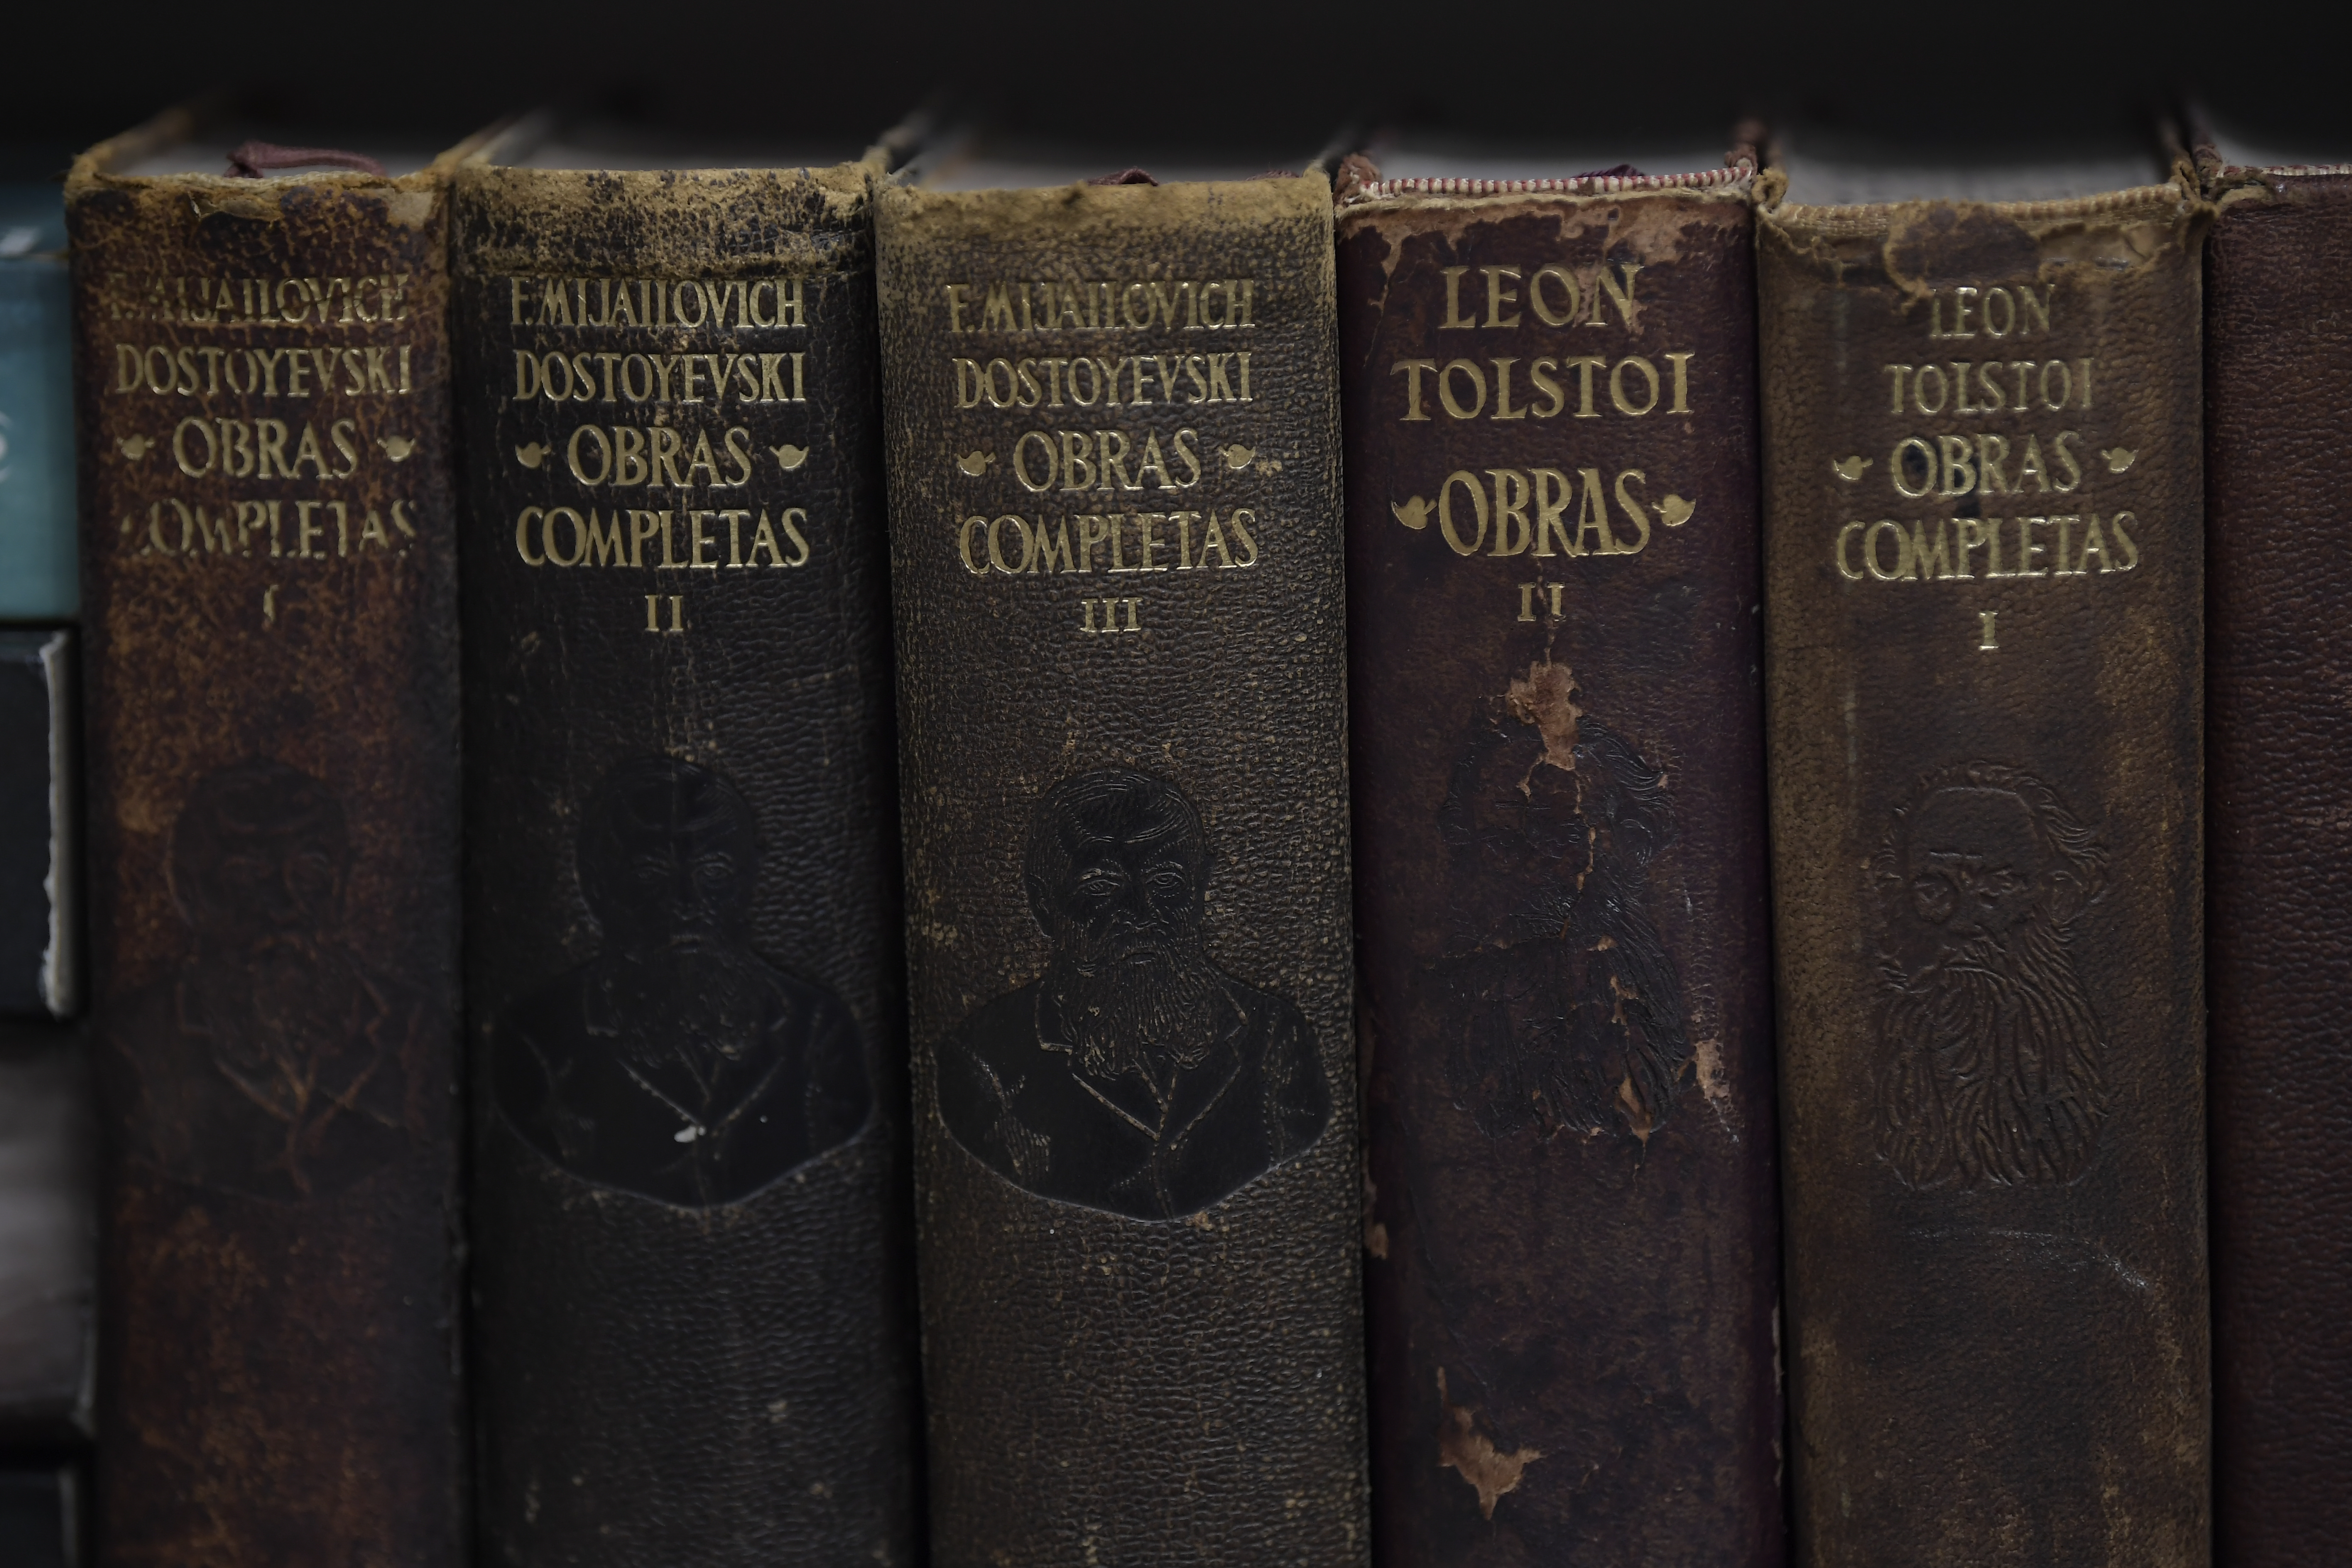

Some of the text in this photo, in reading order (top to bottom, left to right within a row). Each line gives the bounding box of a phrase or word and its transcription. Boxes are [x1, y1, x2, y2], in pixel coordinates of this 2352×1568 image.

[1437, 263, 1644, 332] LEON
[1929, 283, 2055, 338] LEON
[116, 344, 411, 397] DOSTOYEVSKI
[513, 349, 806, 403] DOSTOYEVSKI
[953, 351, 1253, 408] DOSTOYEVSKI
[1390, 351, 1695, 421] TOLSTOI
[1885, 357, 2094, 416] TOLSTOI
[172, 416, 357, 480] OBRAS
[567, 425, 752, 488] OBRAS
[1013, 427, 1201, 492] OBRAS
[1891, 430, 2082, 498] OBRAS
[120, 498, 417, 559] OMPLETAS
[516, 506, 810, 569] COMPLETAS
[959, 508, 1258, 574] COMPLETAS
[1439, 468, 1651, 558] OBRAS
[1837, 510, 2138, 581] COMPLETAS
[645, 595, 684, 632] II
[1080, 596, 1143, 633] III
[1517, 582, 1566, 622] II
[1978, 610, 1999, 651] I
